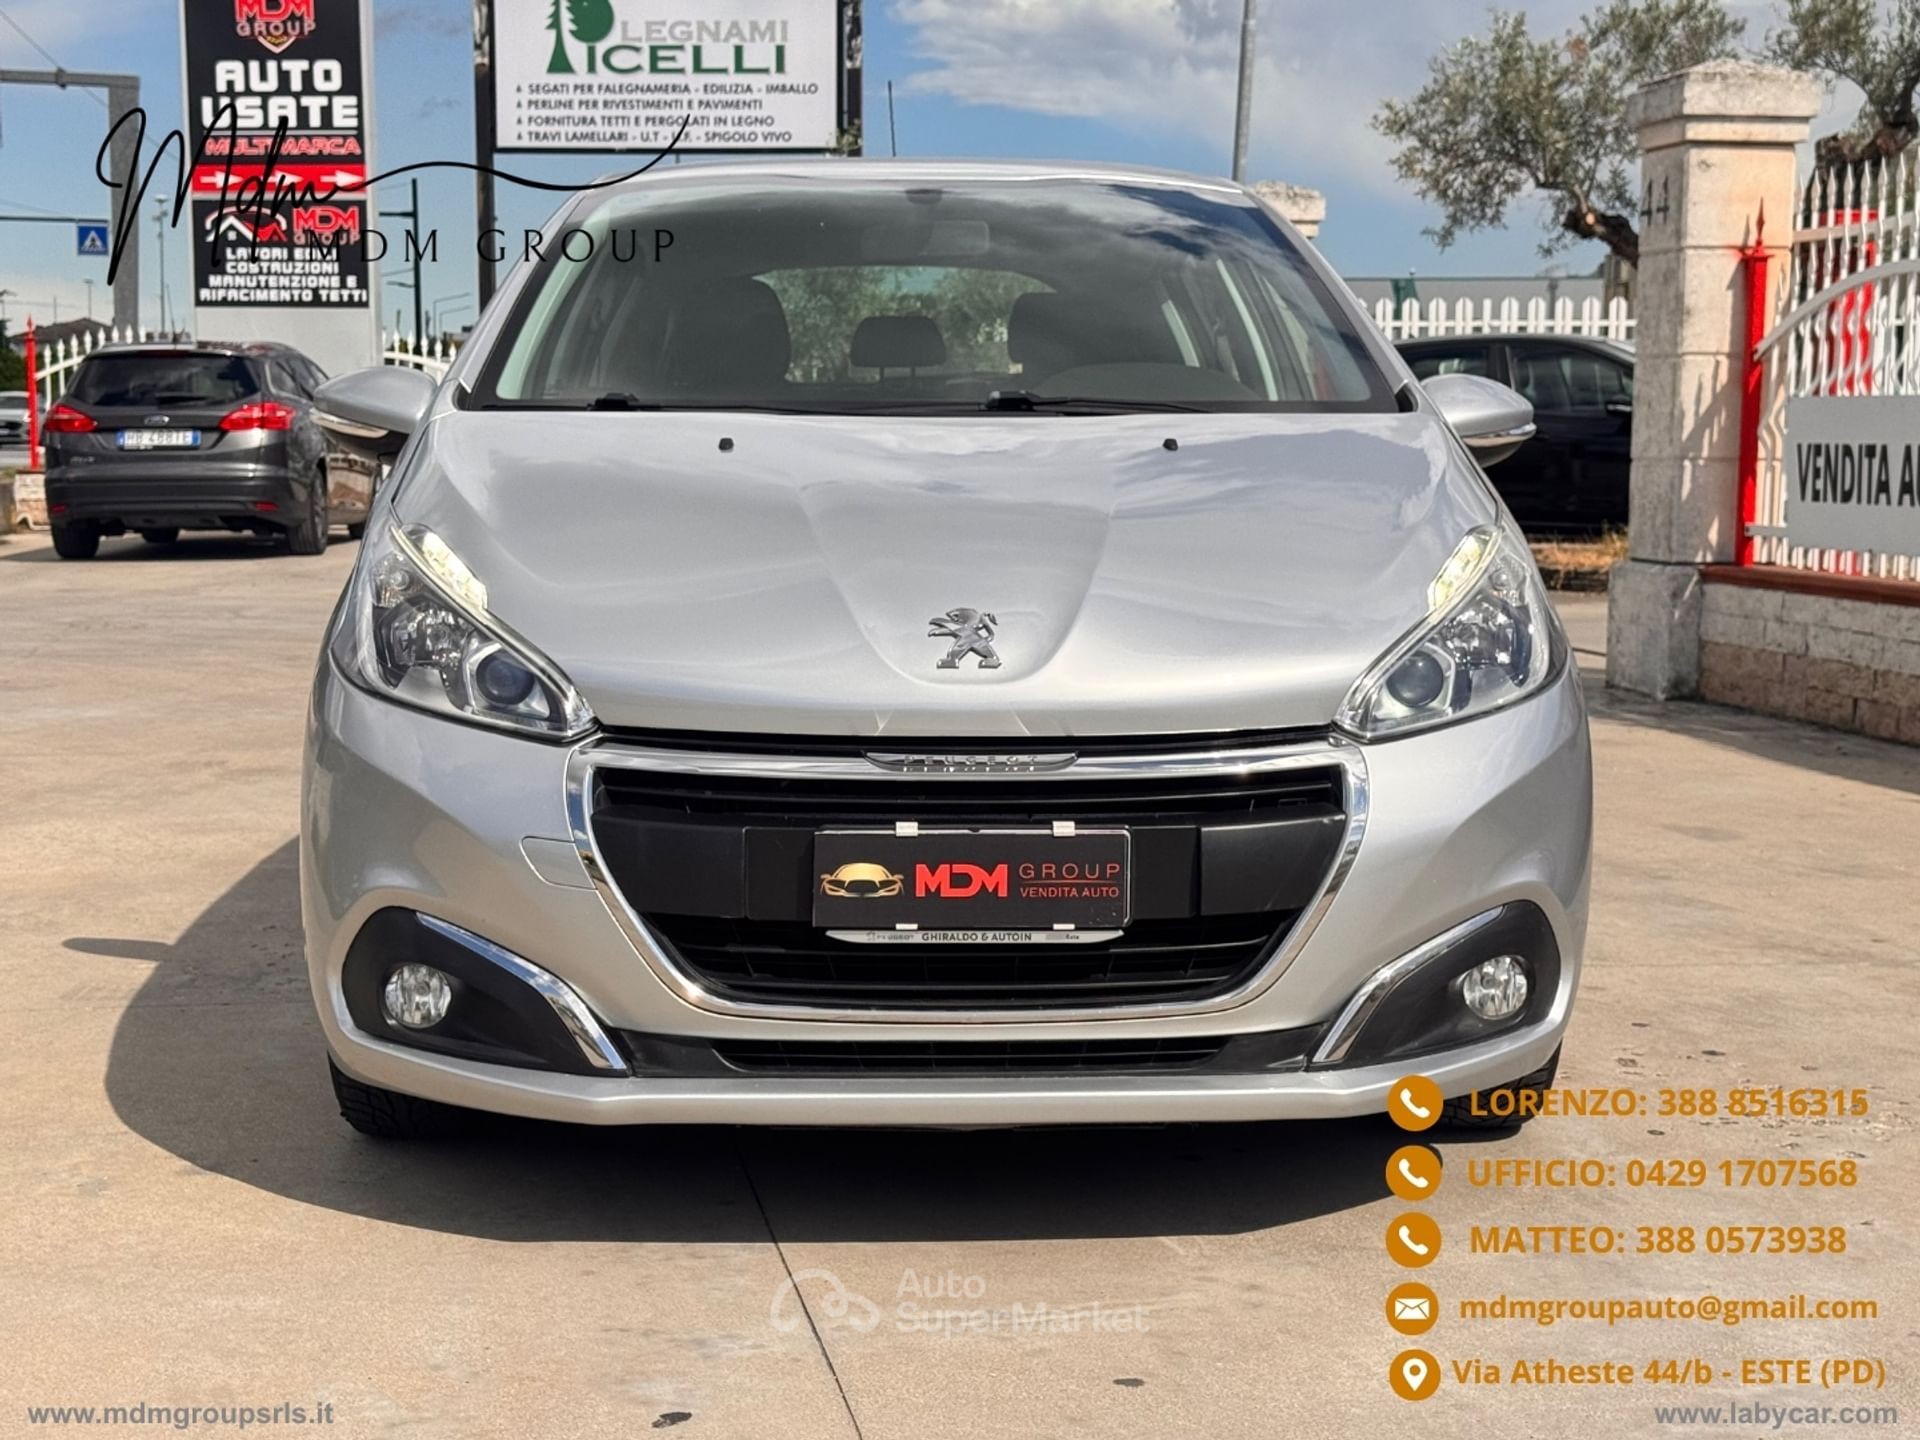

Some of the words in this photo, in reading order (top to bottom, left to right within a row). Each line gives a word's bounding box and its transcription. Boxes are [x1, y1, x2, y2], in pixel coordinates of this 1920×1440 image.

[235, 0, 315, 22] MDM
[236, 20, 316, 36] GROUP
[620, 20, 789, 43] LEGNAMI
[214, 59, 343, 93] AUTO
[527, 83, 570, 94] SEGATI
[573, 83, 594, 94] PER
[597, 83, 691, 94] FALEGNAMERIA
[703, 83, 753, 94] EDILIZIA
[765, 83, 819, 94] IMBALLO
[200, 95, 359, 129] USATE
[527, 99, 574, 110] PERLINE
[578, 99, 599, 110] PER
[602, 99, 684, 110] RIVESTIMENTI
[687, 100, 694, 110] E
[698, 99, 763, 110] PAVIMENTI
[527, 115, 597, 127] FORNITURA
[600, 115, 631, 127] TETTI
[634, 116, 641, 126] E
[713, 115, 728, 127] IN
[731, 115, 775, 127] LEGNO
[527, 131, 561, 142] TRAVI
[564, 131, 628, 142] LAMELLARI
[704, 131, 758, 142] SPIGOLO
[762, 131, 793, 142] VIVO
[205, 135, 362, 156] MULTMARCA
[293, 205, 360, 233] MDM
[226, 261, 339, 274] COSTRUZIONI
[208, 275, 341, 288] MANUTENZIONE
[346, 275, 358, 288] E
[200, 288, 314, 302] RIFACIMENTO
[319, 288, 368, 302] TETTI
[1797, 443, 1892, 506] VENDITA
[1898, 444, 1920, 507] A
[915, 863, 1008, 898] MDM
[1018, 863, 1121, 879] GROUP
[1019, 886, 1079, 898] VENDITA
[1082, 886, 1120, 898] AUTO
[921, 932, 978, 941] GHIRALDO
[980, 932, 989, 941] &
[991, 932, 1032, 941] AUTOIN
